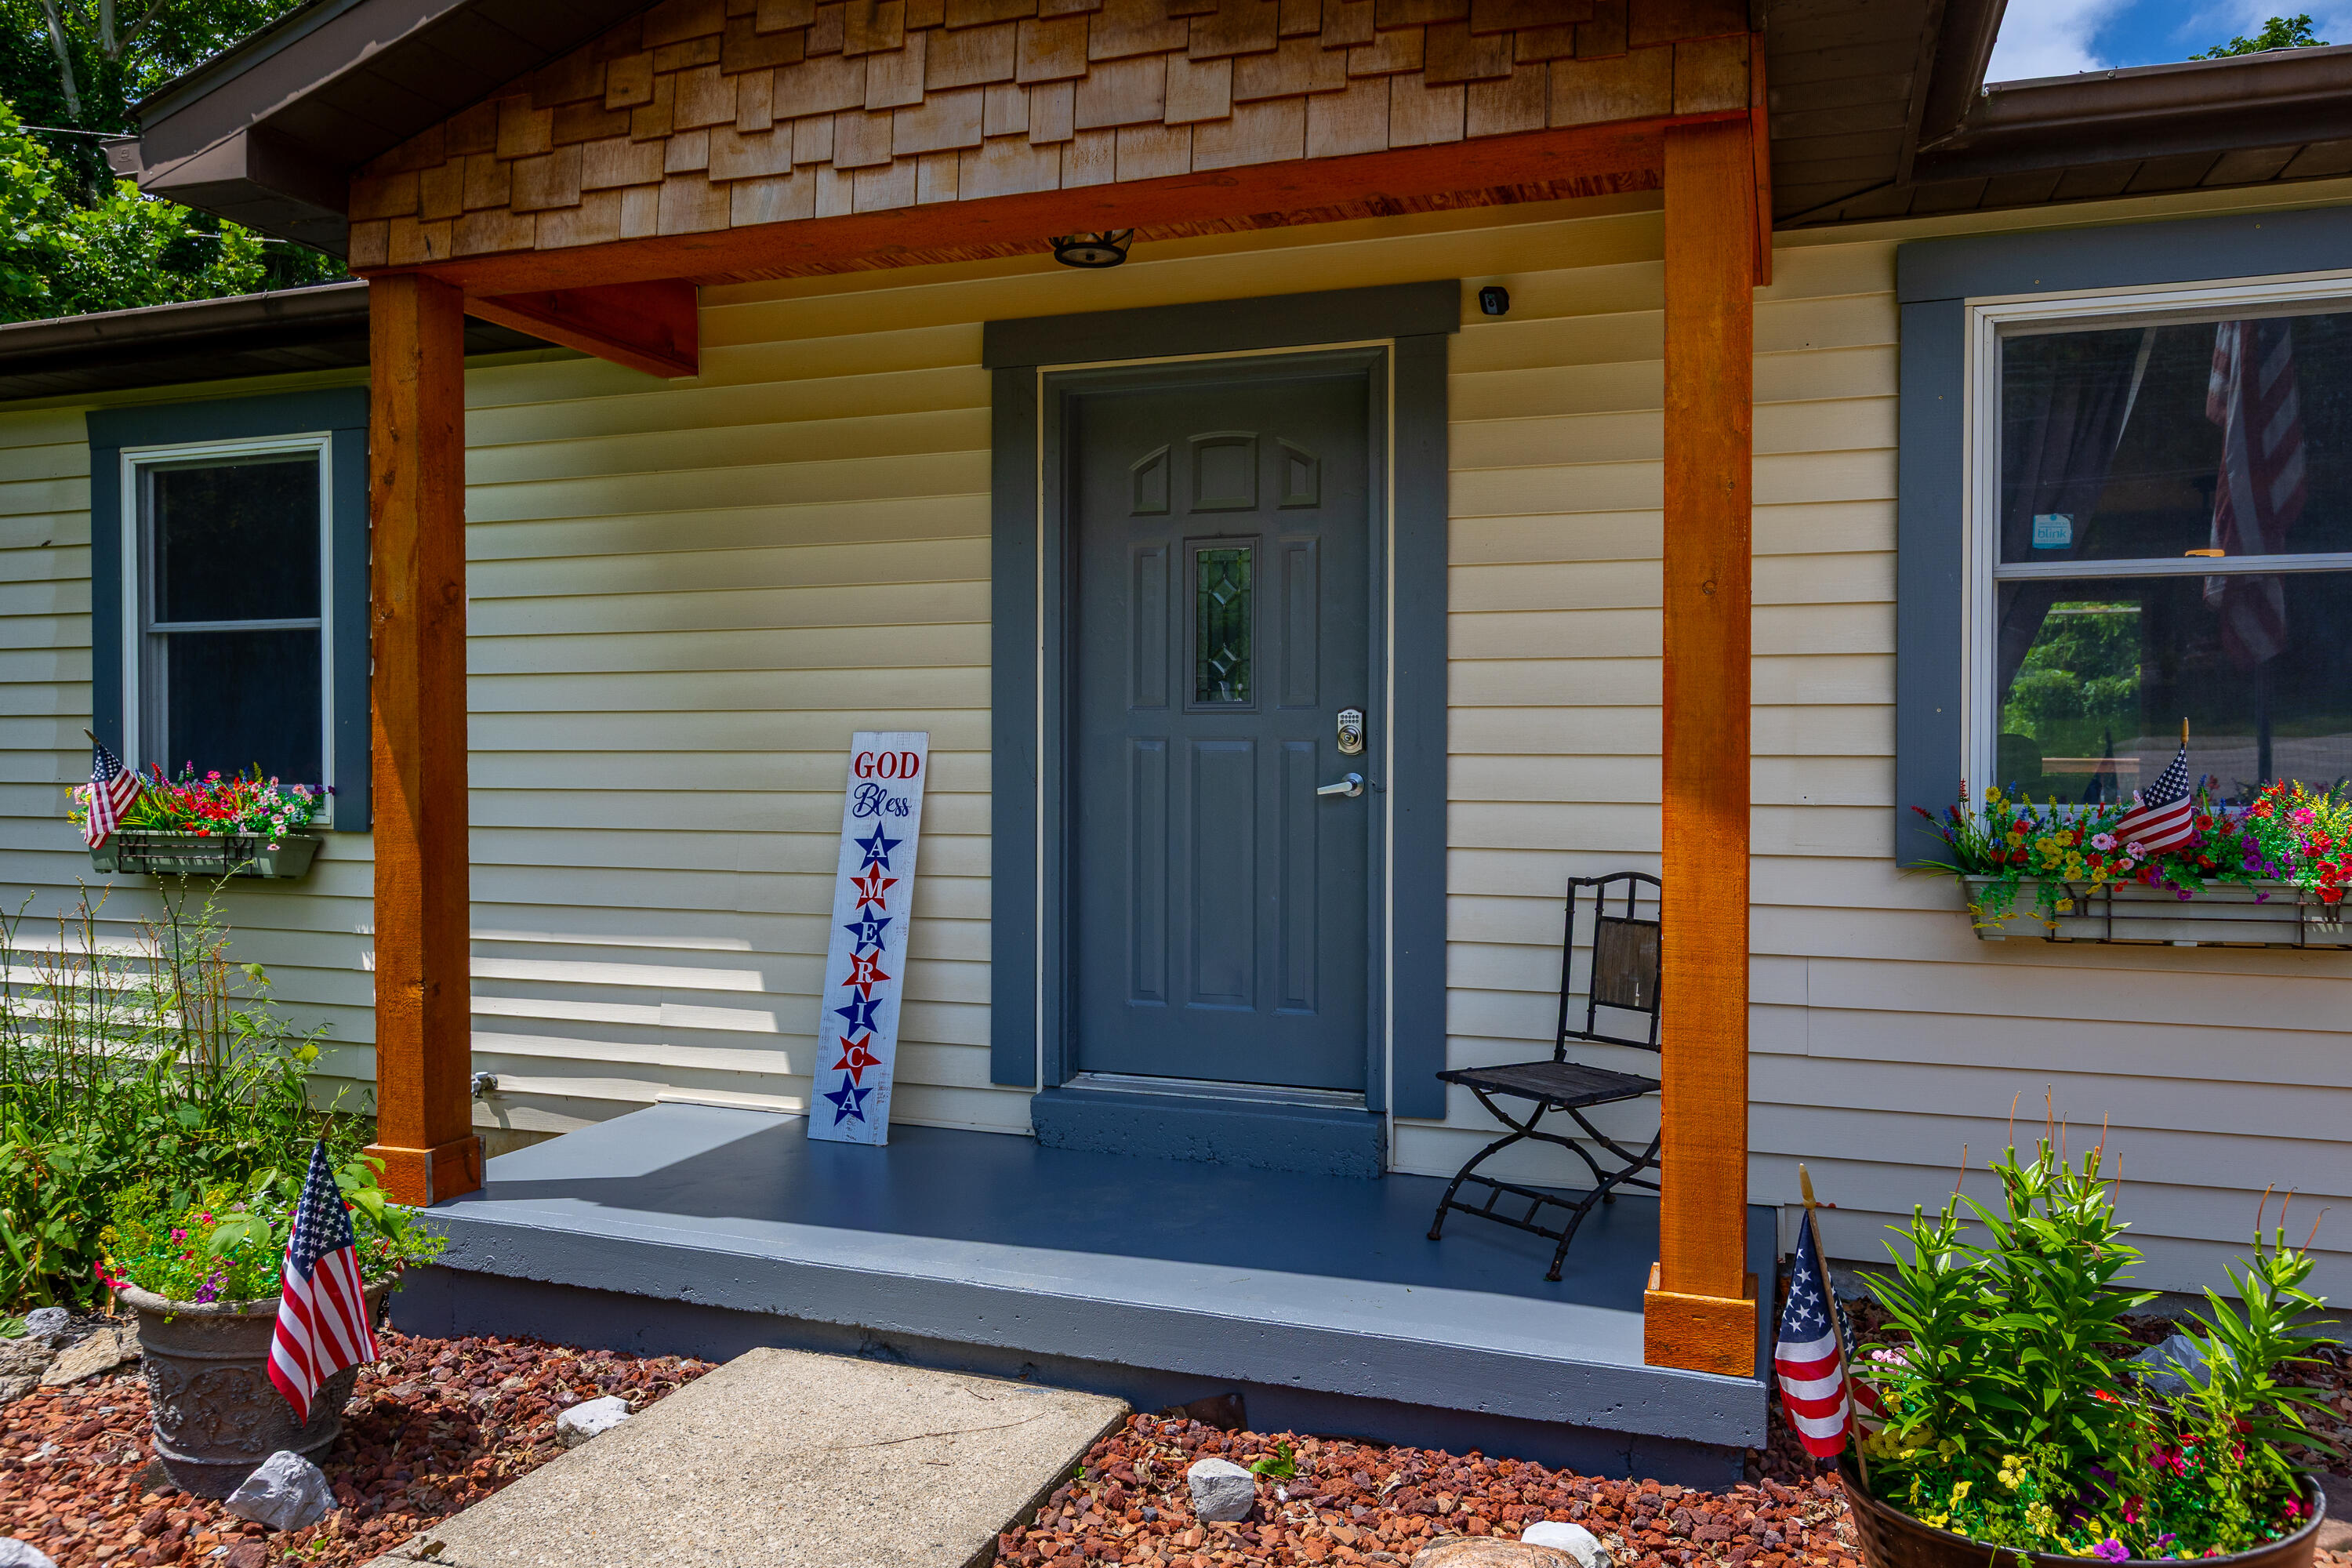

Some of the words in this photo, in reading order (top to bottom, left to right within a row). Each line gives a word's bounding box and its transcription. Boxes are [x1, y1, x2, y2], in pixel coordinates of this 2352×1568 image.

[2038, 528, 2067, 539] blink
[855, 751, 920, 780] GOD
[852, 782, 912, 818] Bless
[838, 837, 887, 1112] AMERICA
